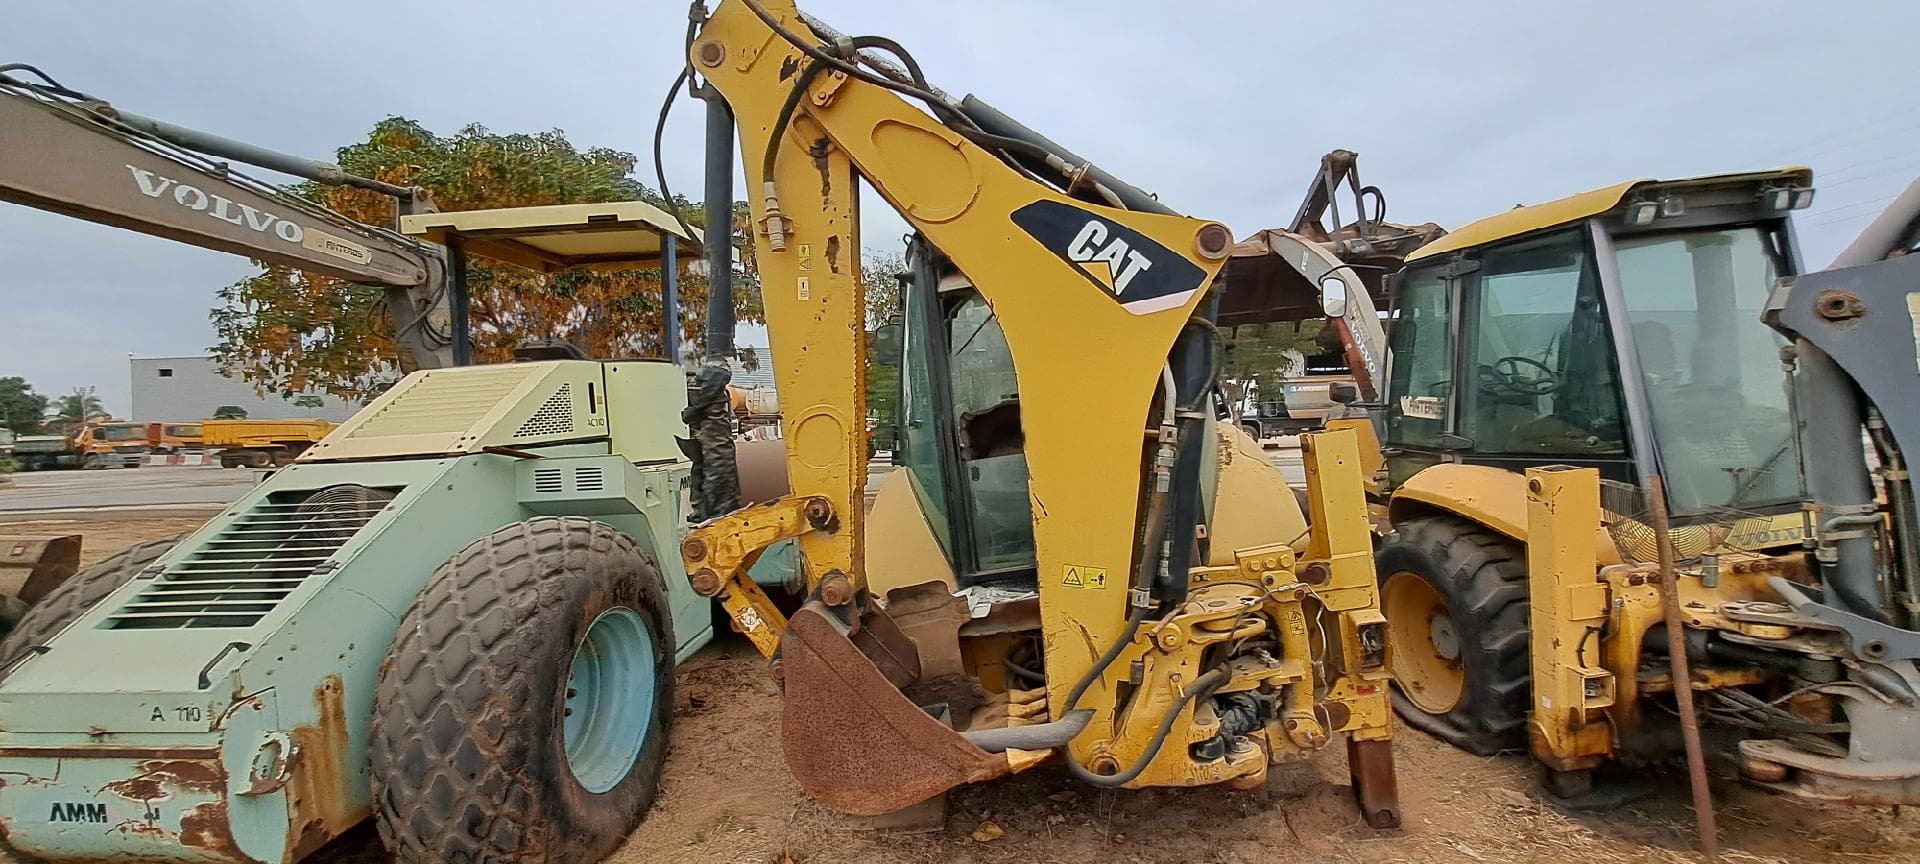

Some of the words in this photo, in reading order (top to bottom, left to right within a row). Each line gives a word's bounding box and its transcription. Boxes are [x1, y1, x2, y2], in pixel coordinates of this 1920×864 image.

[126, 164, 304, 243] VOLVO
[1068, 220, 1152, 296] CAT
[1731, 528, 1806, 546] VOLV
